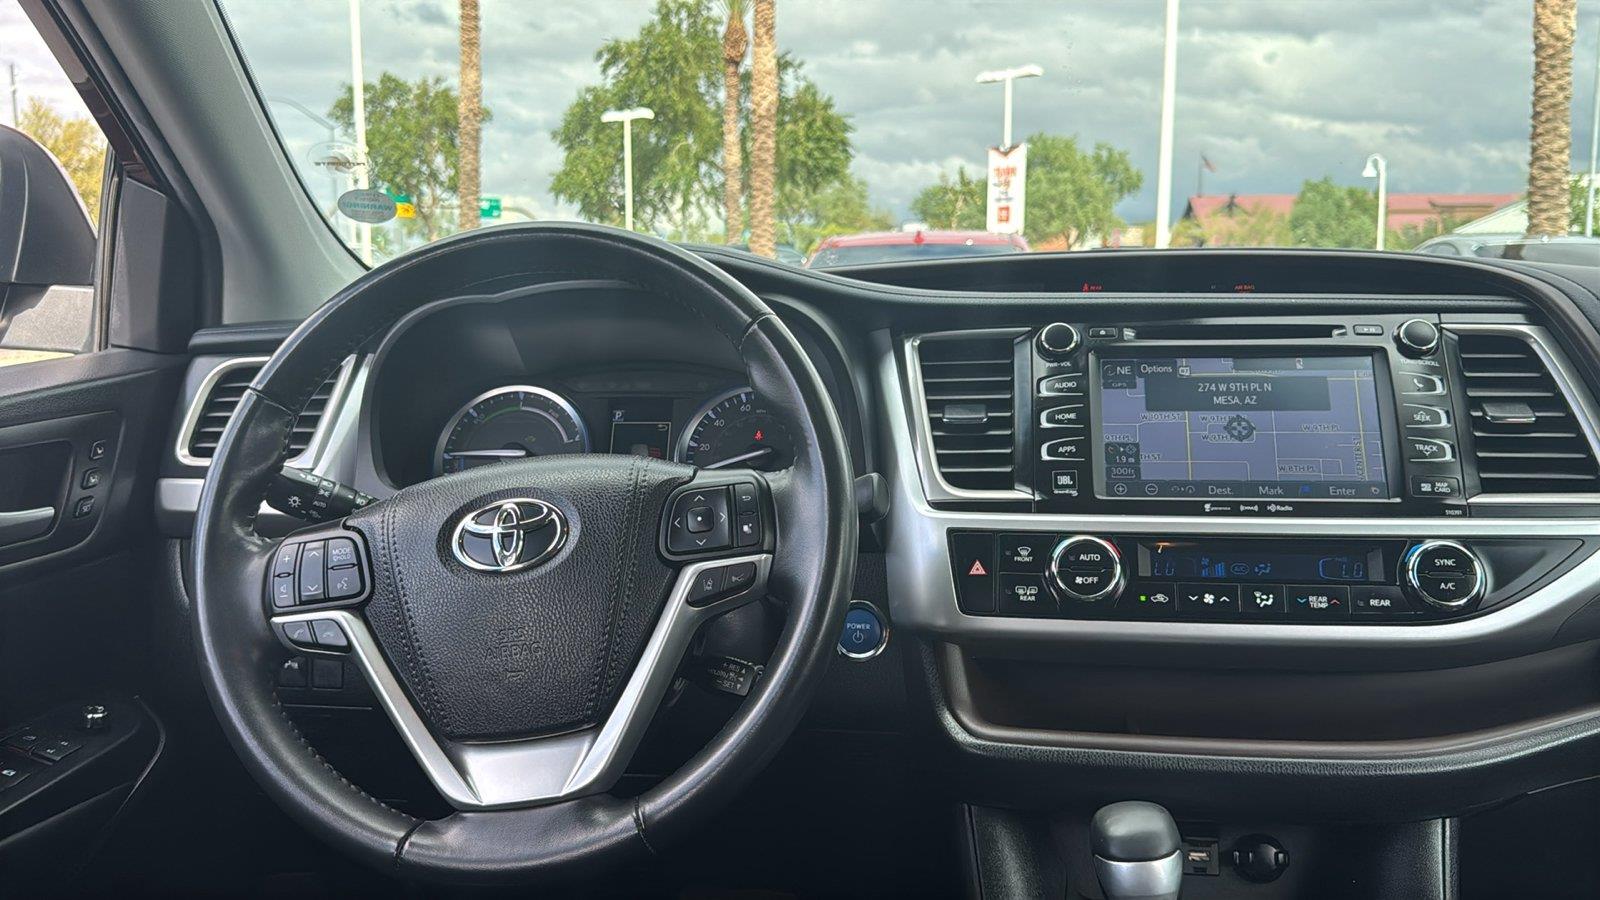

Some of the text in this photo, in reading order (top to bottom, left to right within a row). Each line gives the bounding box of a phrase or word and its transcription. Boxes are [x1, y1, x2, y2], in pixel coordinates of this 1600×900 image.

[1116, 366, 1132, 375] NE
[1140, 364, 1173, 375] Options
[1053, 381, 1078, 389] AUDIO
[1197, 382, 1272, 392] 274 W 9TH PL N
[1244, 396, 1258, 405] AZ
[740, 404, 751, 412] 60
[1054, 412, 1078, 421] HOME
[1170, 412, 1181, 420] ST
[1413, 412, 1431, 423] SEEK
[714, 420, 725, 428] 40
[700, 443, 711, 451] 20
[1057, 445, 1077, 453] APPS
[1414, 444, 1438, 452] TRACK
[1057, 475, 1074, 485] JBL
[1208, 485, 1234, 496] Dest.
[1258, 485, 1284, 496] Mark
[1329, 486, 1357, 496] Enter
[332, 547, 352, 556] MODE
[1434, 558, 1457, 567] SYNC
[1082, 576, 1099, 584] OFF
[1439, 582, 1456, 590] A/C
[1369, 599, 1391, 607] REAR
[846, 622, 871, 630] POWER
[500, 626, 525, 641] SRS
[484, 641, 543, 662] AIRBAG
